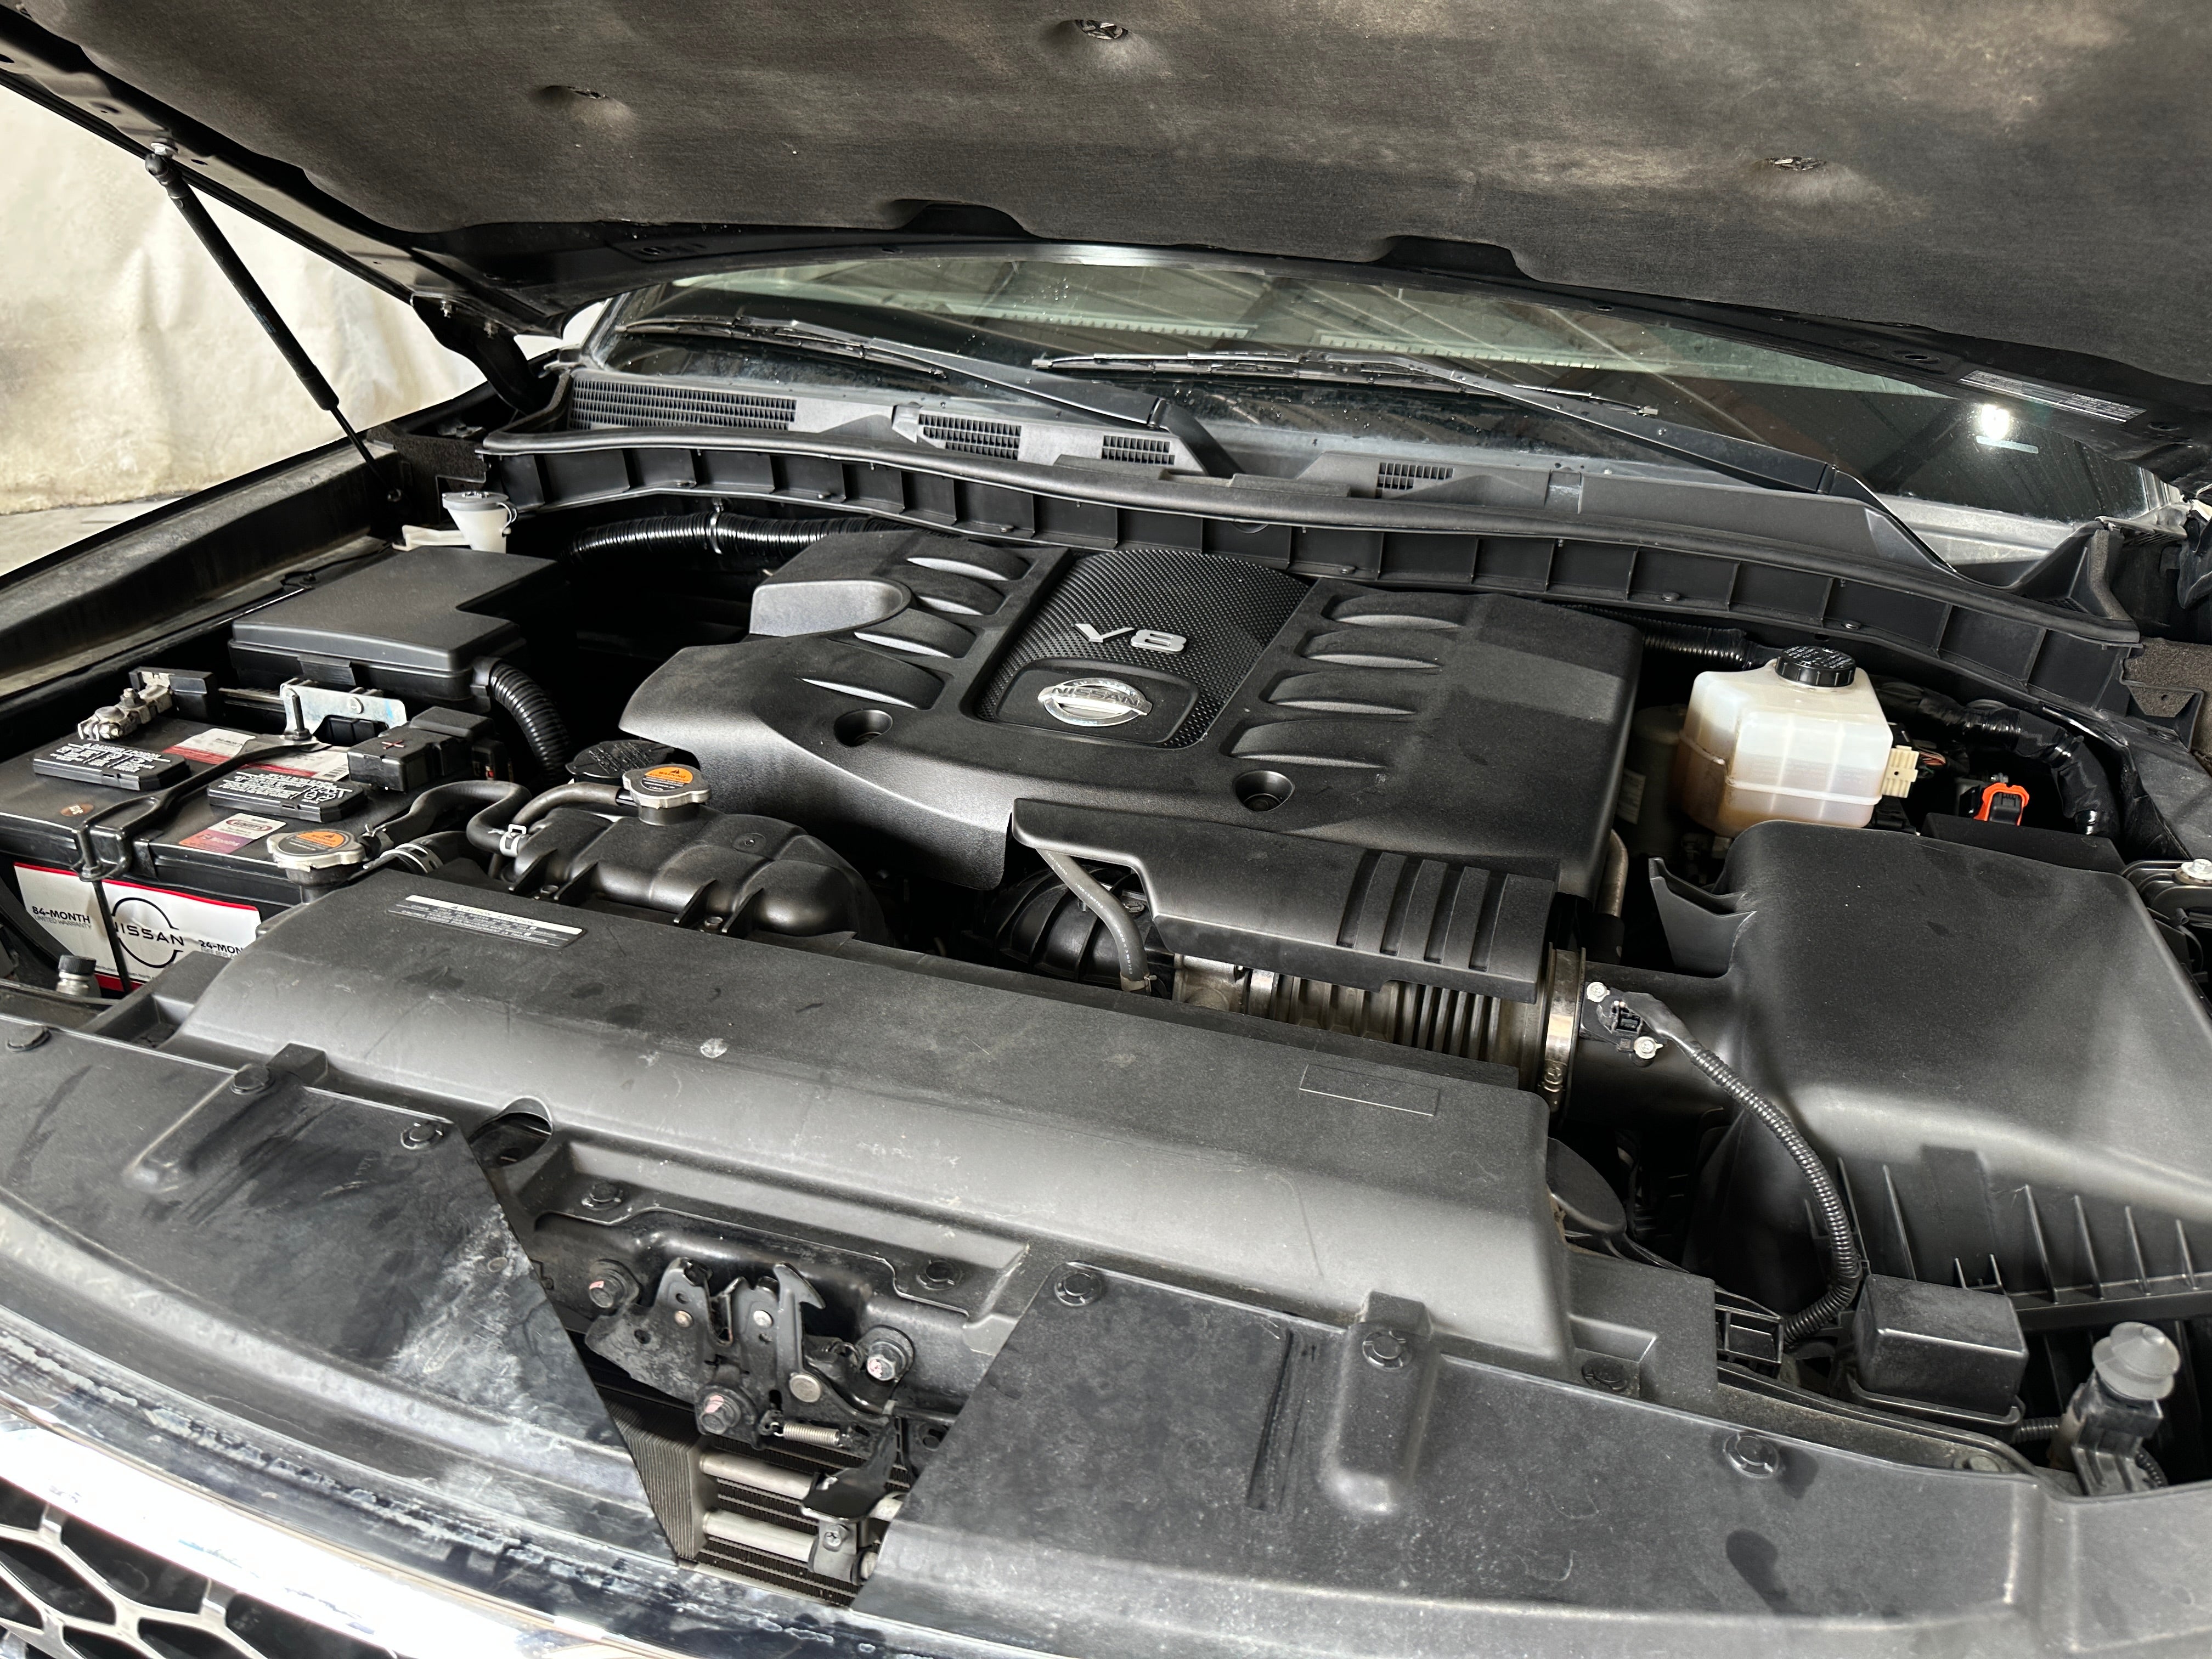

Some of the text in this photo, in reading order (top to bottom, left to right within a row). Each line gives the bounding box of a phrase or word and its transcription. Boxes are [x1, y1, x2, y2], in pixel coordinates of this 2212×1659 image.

[1074, 623, 1188, 654] V8
[1051, 686, 1142, 707] NISSAN
[32, 906, 91, 924] 84-MONTH
[461, 907, 492, 916] CAUTION
[498, 915, 535, 924] ATTENTION
